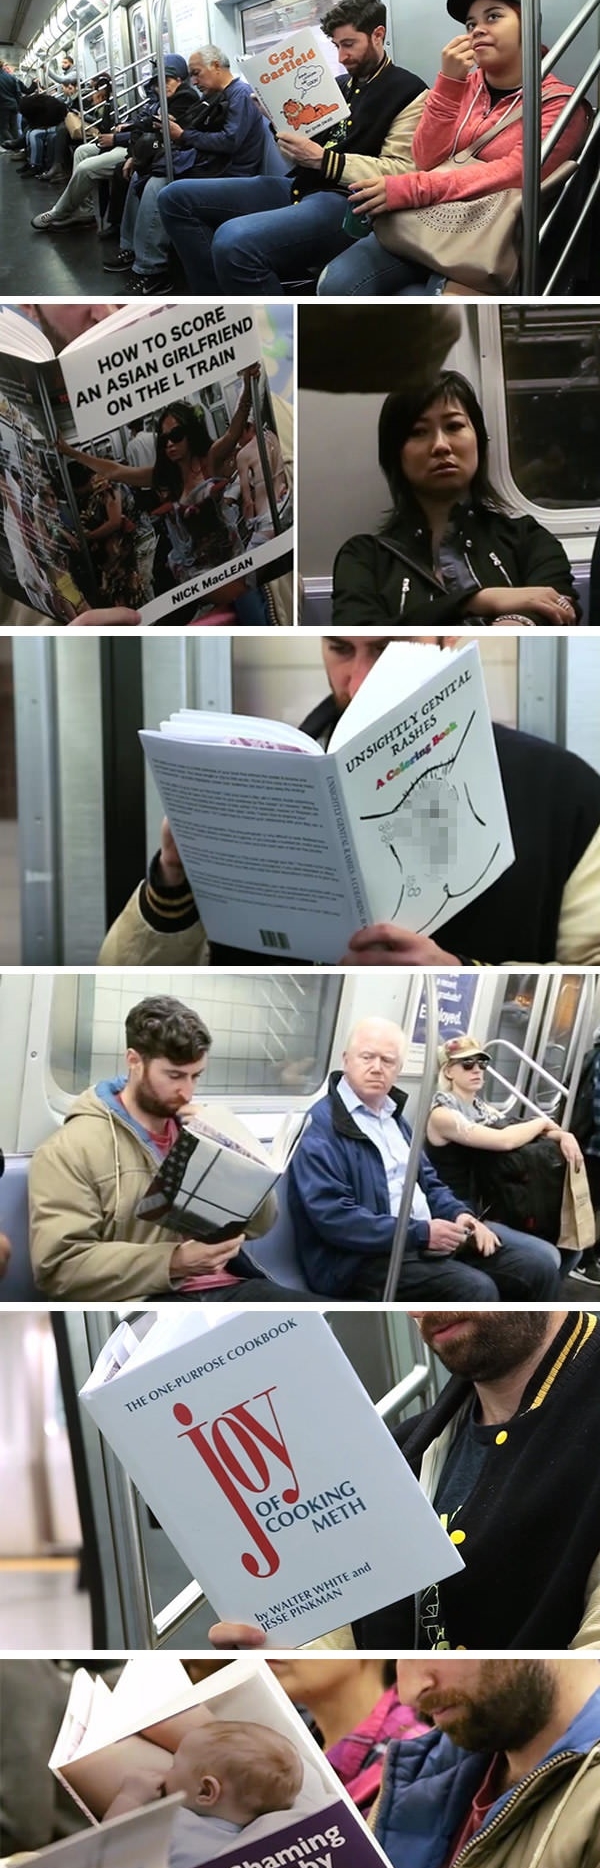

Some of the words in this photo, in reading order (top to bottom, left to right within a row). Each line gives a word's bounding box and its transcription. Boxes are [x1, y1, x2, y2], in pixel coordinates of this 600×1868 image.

[259, 48, 316, 85] Garfield
[268, 46, 295, 66] Gay
[75, 384, 102, 408] AN
[106, 359, 159, 395] ASIAN
[162, 316, 254, 369] GIRLFRIEND
[97, 343, 139, 374] HOW
[142, 332, 167, 354] TO
[170, 306, 227, 342] SCORE
[106, 395, 134, 417] ON
[135, 376, 171, 404] THE
[172, 372, 185, 387] L
[186, 346, 236, 380] TRAIN
[171, 585, 201, 606] NICK
[201, 557, 255, 592] MacLEAN
[345, 712, 419, 774] UNSIGHTLY
[420, 669, 472, 716] GENITAL
[391, 715, 438, 757] RASHES
[124, 1396, 148, 1413] THE
[148, 1355, 226, 1403] ONE-PURPOSE
[226, 1317, 299, 1362] COOKBOOK
[172, 1386, 300, 1579] joy
[255, 1495, 281, 1518] OF
[265, 1480, 356, 1534] COOKING
[311, 1497, 368, 1534] METH
